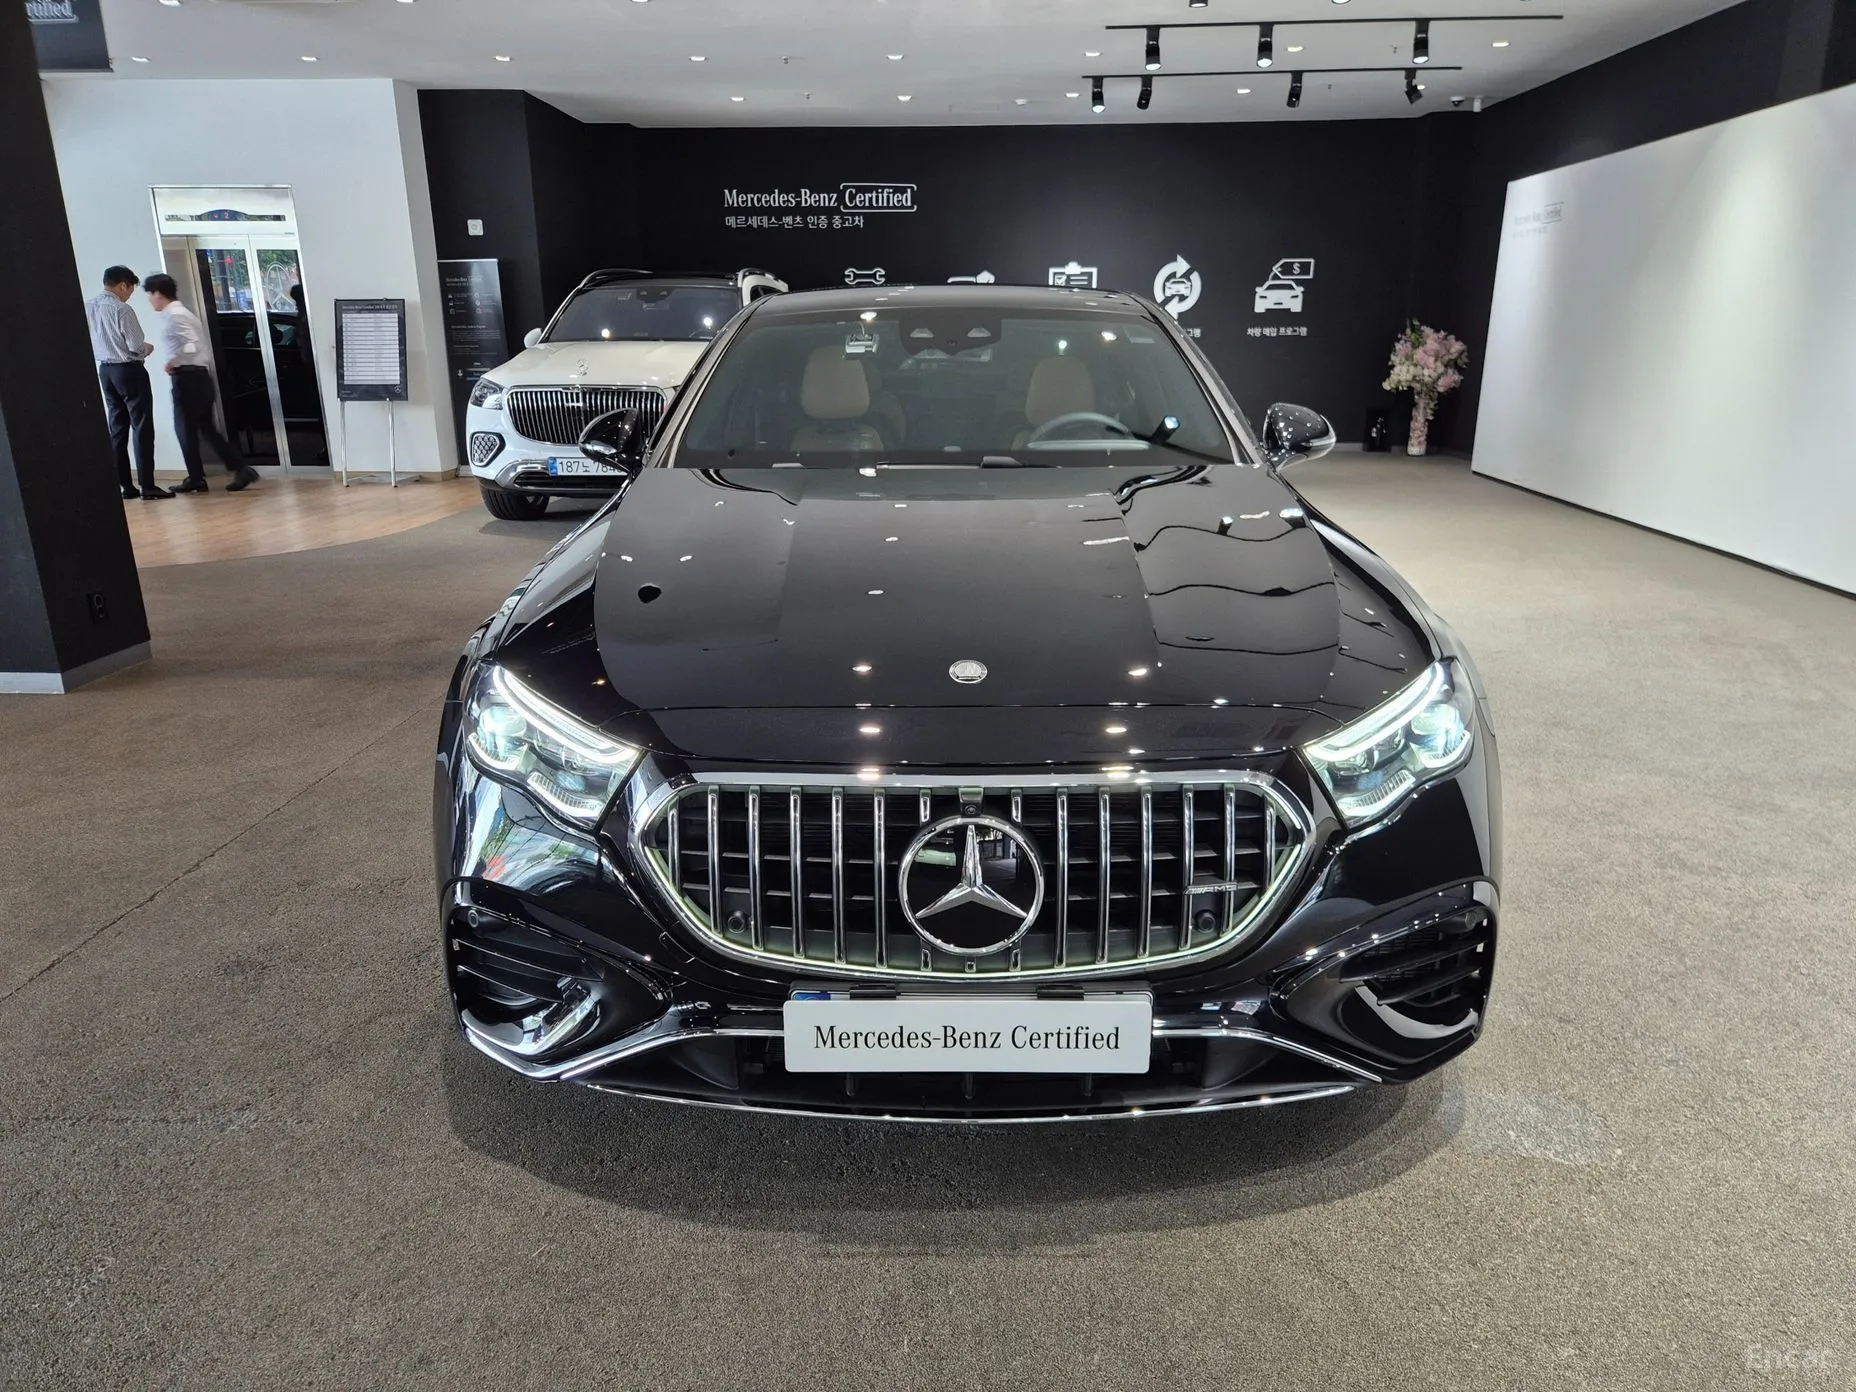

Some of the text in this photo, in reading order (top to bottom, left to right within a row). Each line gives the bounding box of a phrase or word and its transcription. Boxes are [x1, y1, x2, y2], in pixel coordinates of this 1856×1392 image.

[25, 0, 73, 18] rtified
[723, 188, 912, 208] Mercedes-Benz Certified
[725, 215, 865, 229] 메르세데스-벤츠 인증 중고차
[1246, 326, 1261, 338] 차량
[1279, 326, 1308, 337] 프로그램
[559, 460, 590, 473] 187노
[813, 1025, 1120, 1050] Mercedes-Benz Certified
